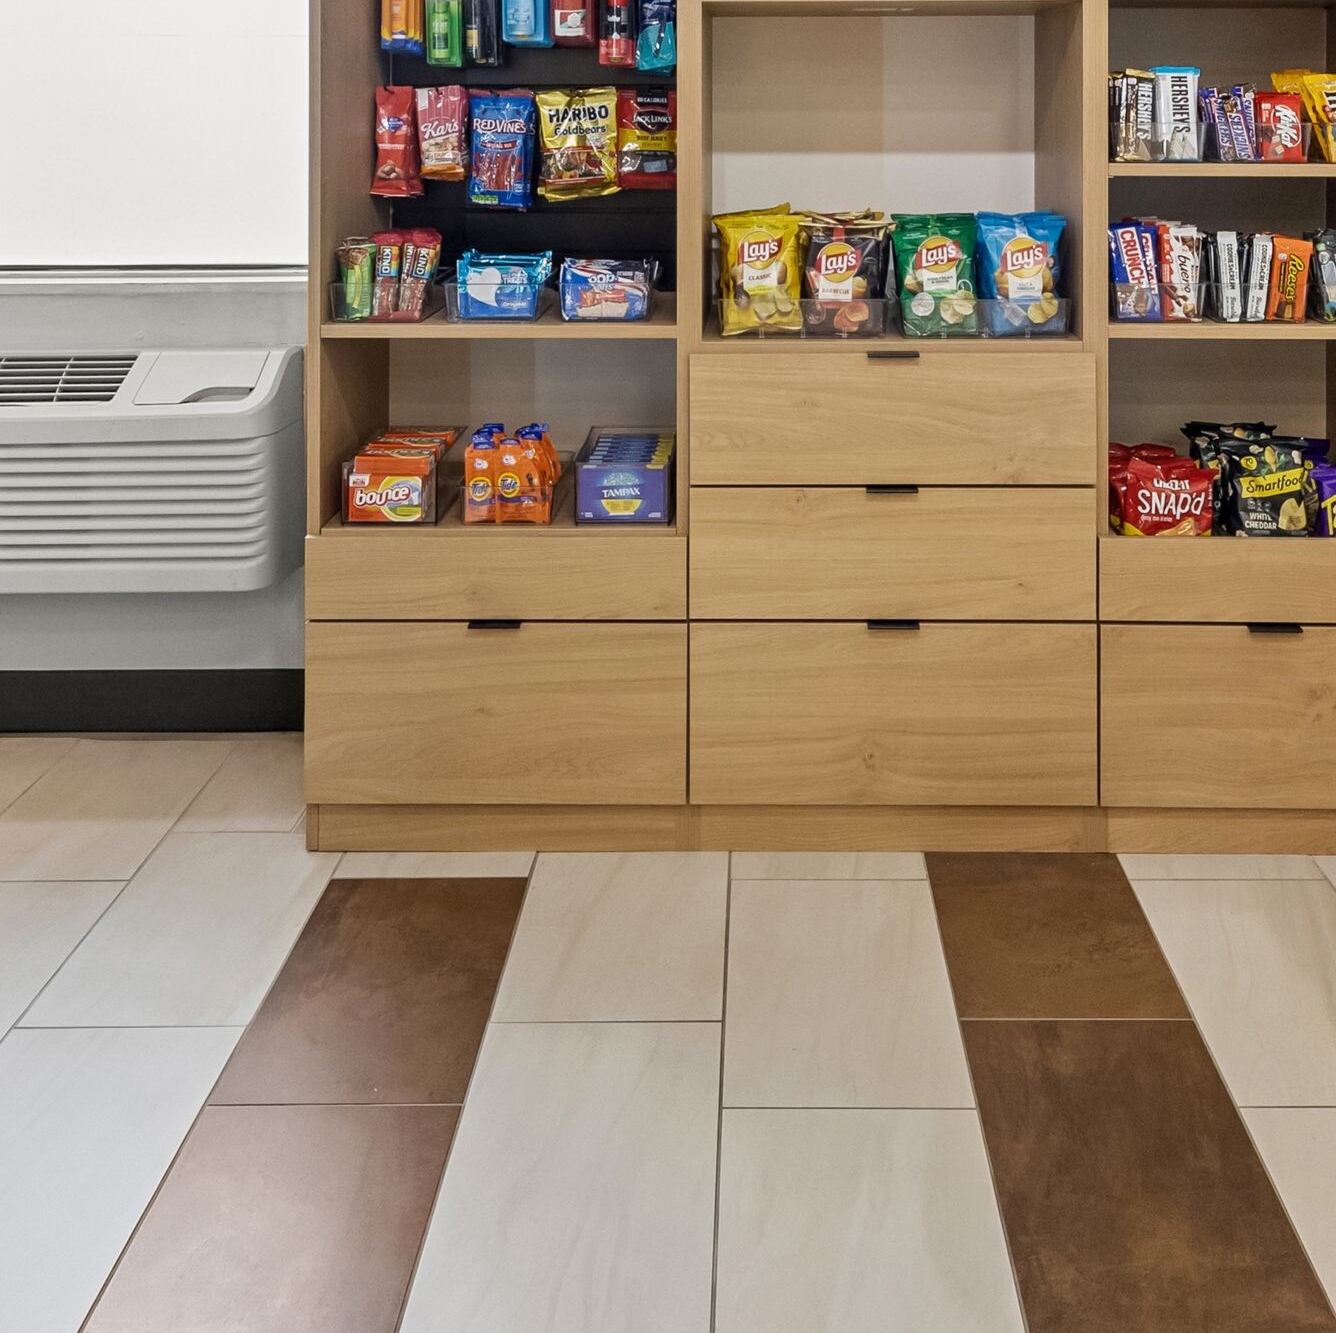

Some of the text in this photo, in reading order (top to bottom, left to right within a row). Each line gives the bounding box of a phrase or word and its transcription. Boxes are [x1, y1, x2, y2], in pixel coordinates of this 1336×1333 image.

[548, 105, 609, 124] HARIBO
[421, 118, 459, 139] Kar's
[473, 118, 526, 134] RED VINES
[554, 125, 606, 136] Goldbears
[1229, 115, 1251, 158] SNICKERS
[381, 248, 391, 274] KIND
[416, 249, 429, 275] KIND
[743, 239, 779, 264] Lay's
[921, 243, 957, 267] Lay's
[1007, 246, 1043, 272] Lay's
[1120, 229, 1148, 286] CRUNCH
[820, 250, 856, 276] Lay's
[1286, 253, 1305, 301] Reese's
[471, 483, 489, 495] Tide
[500, 479, 517, 491] Tide
[602, 487, 641, 498] TAMPAX
[1246, 475, 1303, 493] Smartfood
[355, 486, 410, 507] bounce
[1245, 521, 1277, 530] CHEDDAR
[1249, 513, 1272, 521] WHITE
